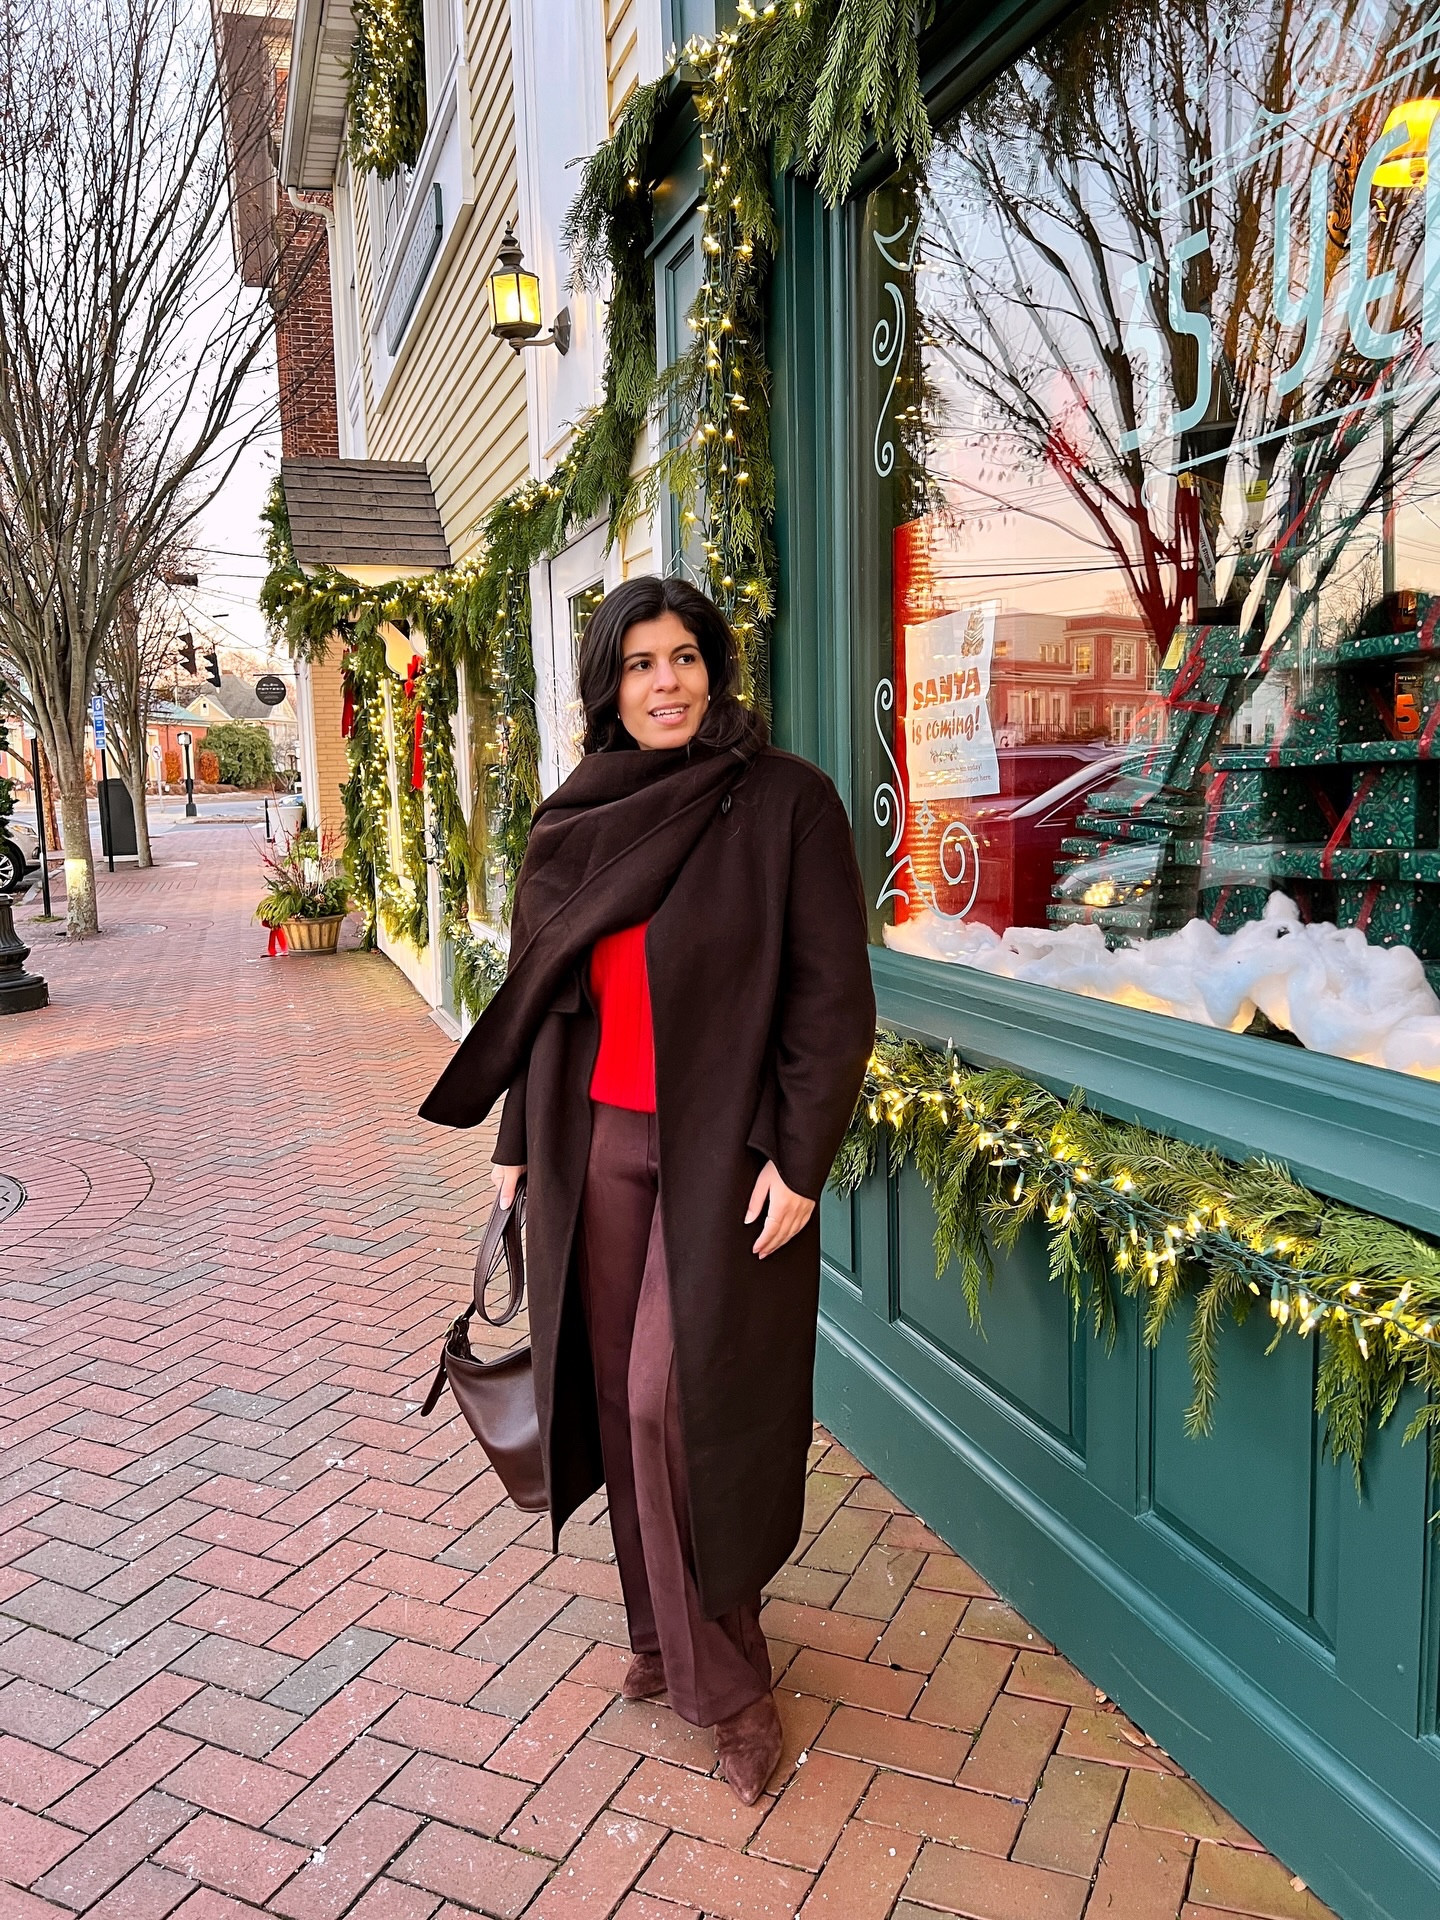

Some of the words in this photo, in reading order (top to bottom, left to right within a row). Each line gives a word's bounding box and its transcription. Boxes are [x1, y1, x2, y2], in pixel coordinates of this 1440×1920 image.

[913, 667, 981, 710] SANTA
[912, 719, 922, 745] is
[926, 705, 980, 741] coming!
[1396, 693, 1420, 734] 5
